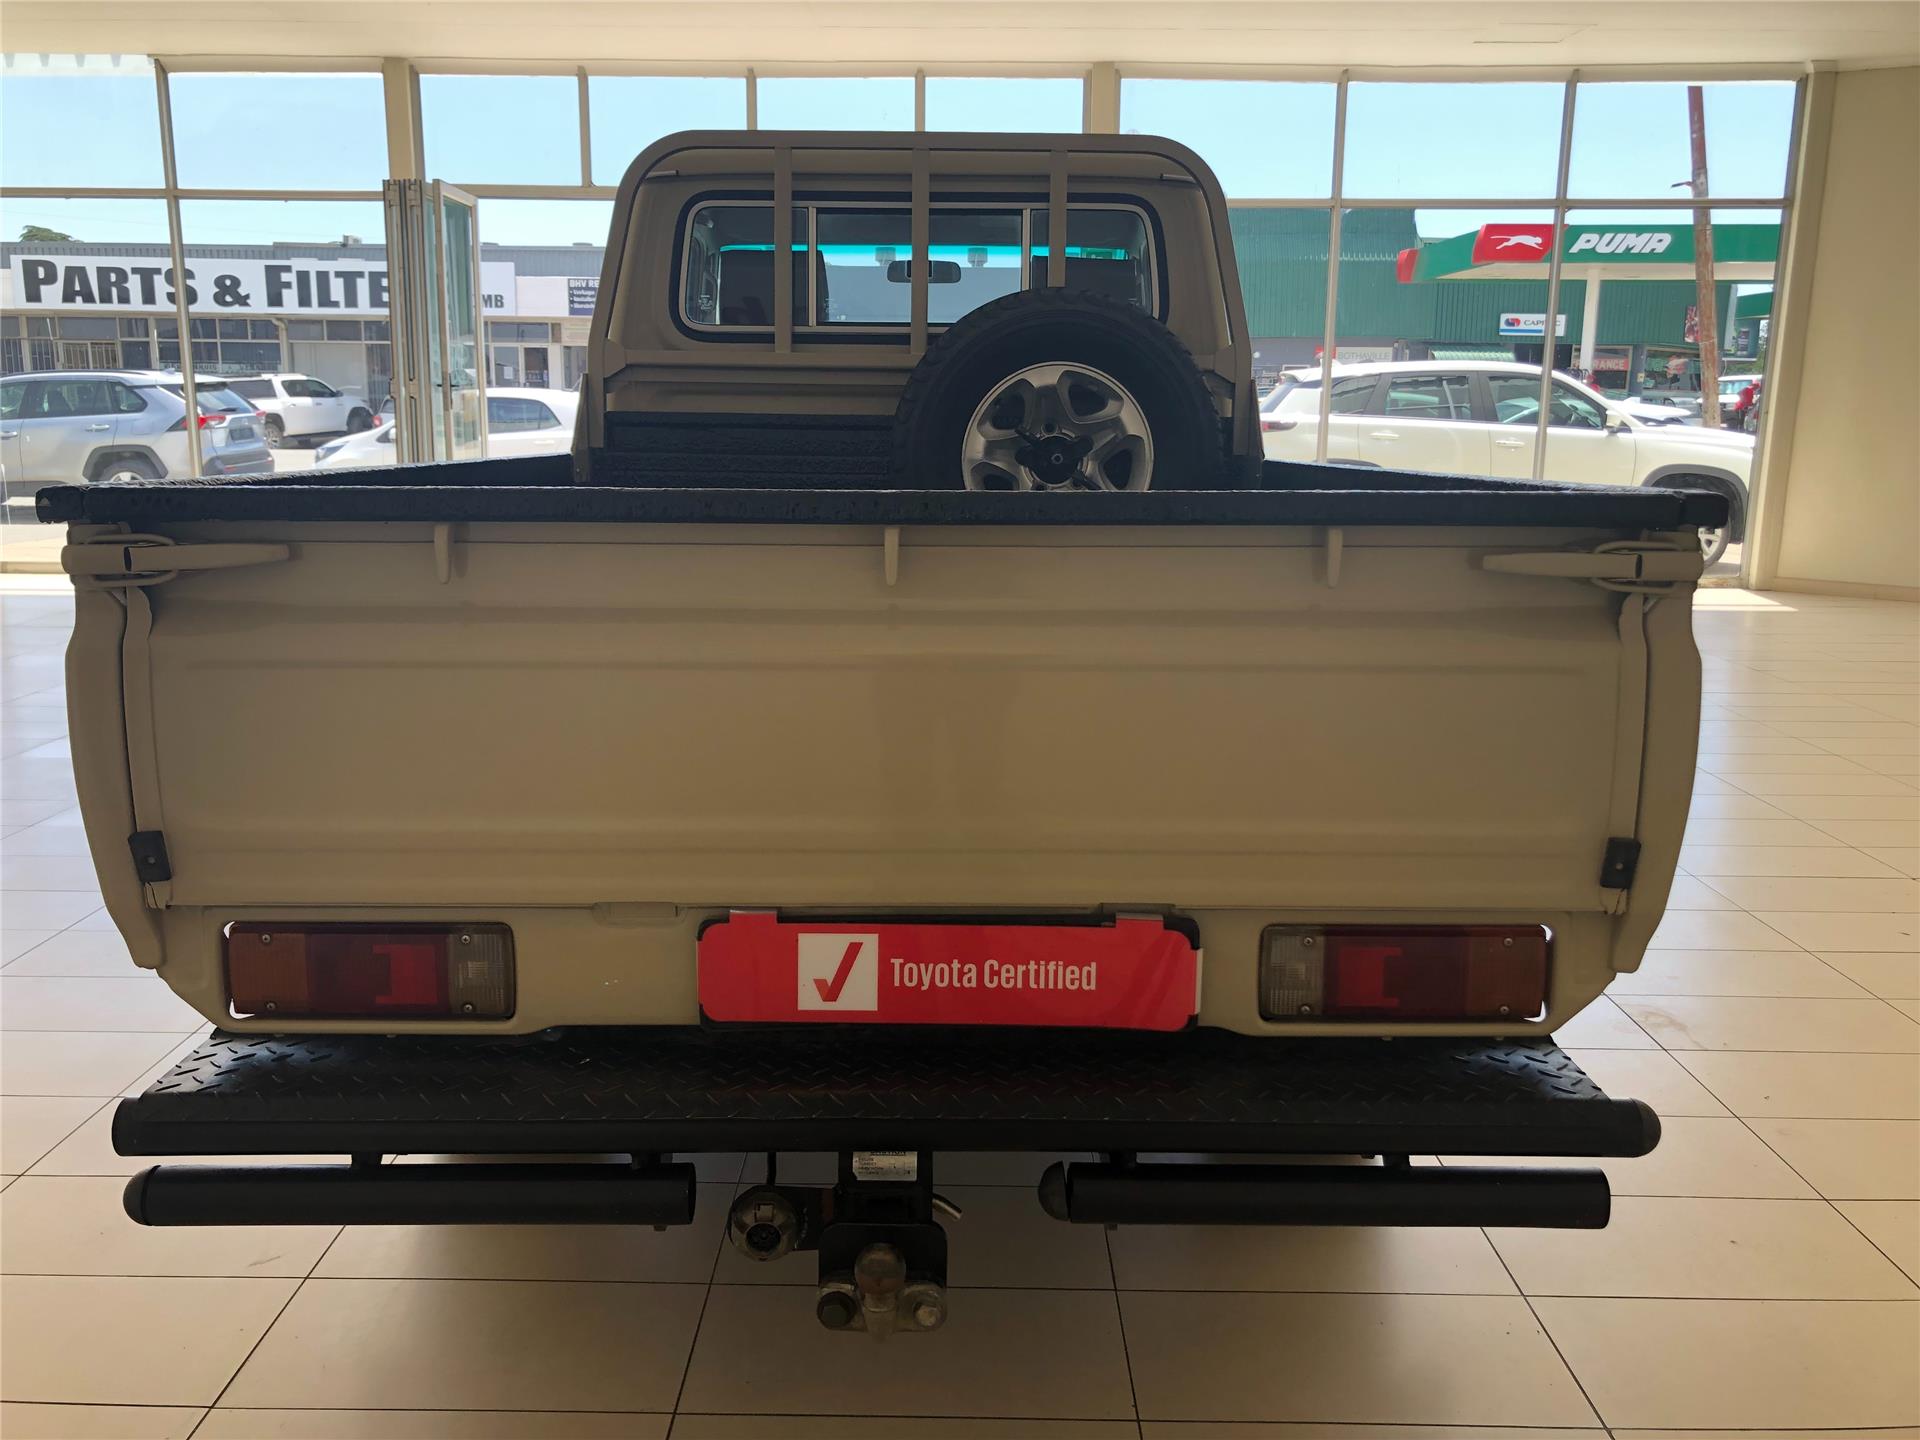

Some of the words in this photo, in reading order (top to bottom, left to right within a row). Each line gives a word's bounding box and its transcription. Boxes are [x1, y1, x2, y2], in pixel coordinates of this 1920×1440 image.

[1568, 233, 1672, 254] PUMA
[22, 259, 198, 306] PARTS
[213, 274, 251, 308] &
[890, 958, 977, 991] Toyota
[984, 959, 1097, 990] Certified
